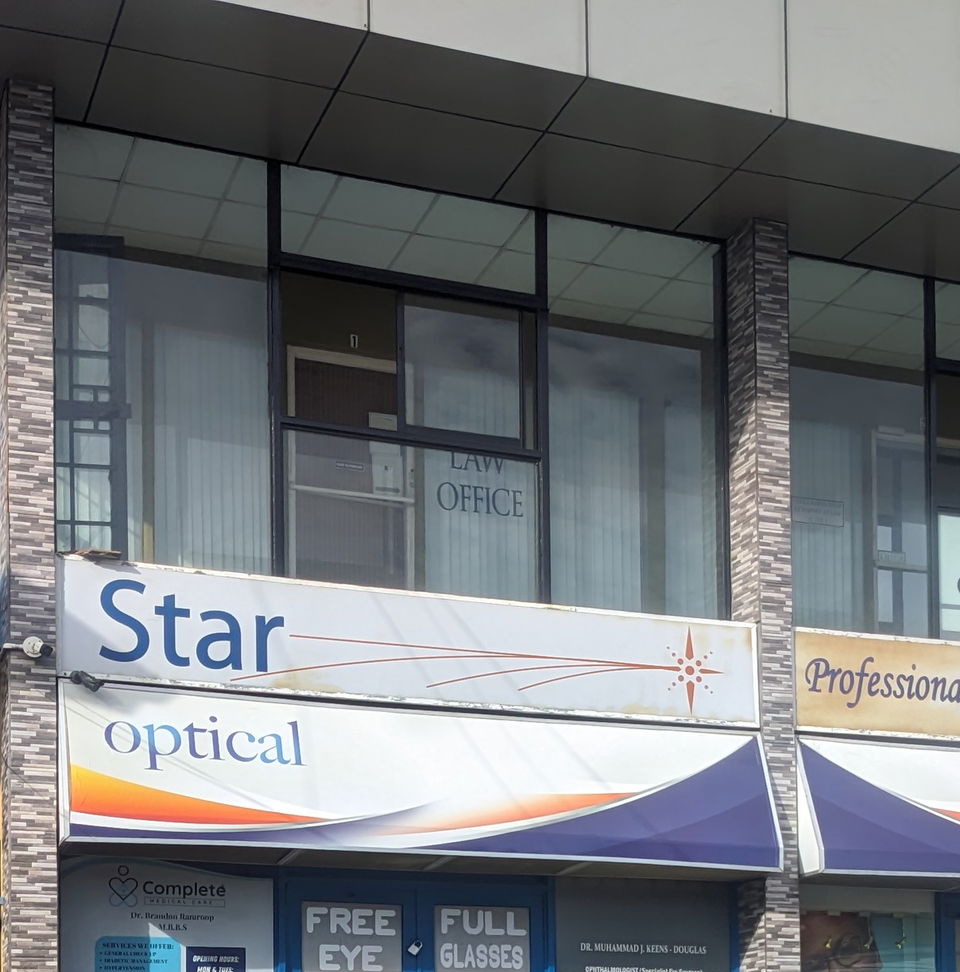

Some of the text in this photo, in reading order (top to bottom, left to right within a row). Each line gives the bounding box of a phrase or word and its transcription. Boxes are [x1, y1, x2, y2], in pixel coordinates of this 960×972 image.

[451, 452, 504, 475] LAW
[437, 482, 524, 518] OFFICE
[99, 579, 285, 673] Star
[103, 716, 306, 773] optical
[143, 880, 226, 904] Complete
[306, 907, 528, 937] FREE FULL
[318, 942, 524, 972] EYE GLASSES
[580, 943, 593, 952] DR.
[594, 943, 640, 953] MUHAMMAD
[640, 944, 645, 955] J.
[646, 944, 668, 954] KEENS
[673, 945, 707, 955] DOUGLAS
